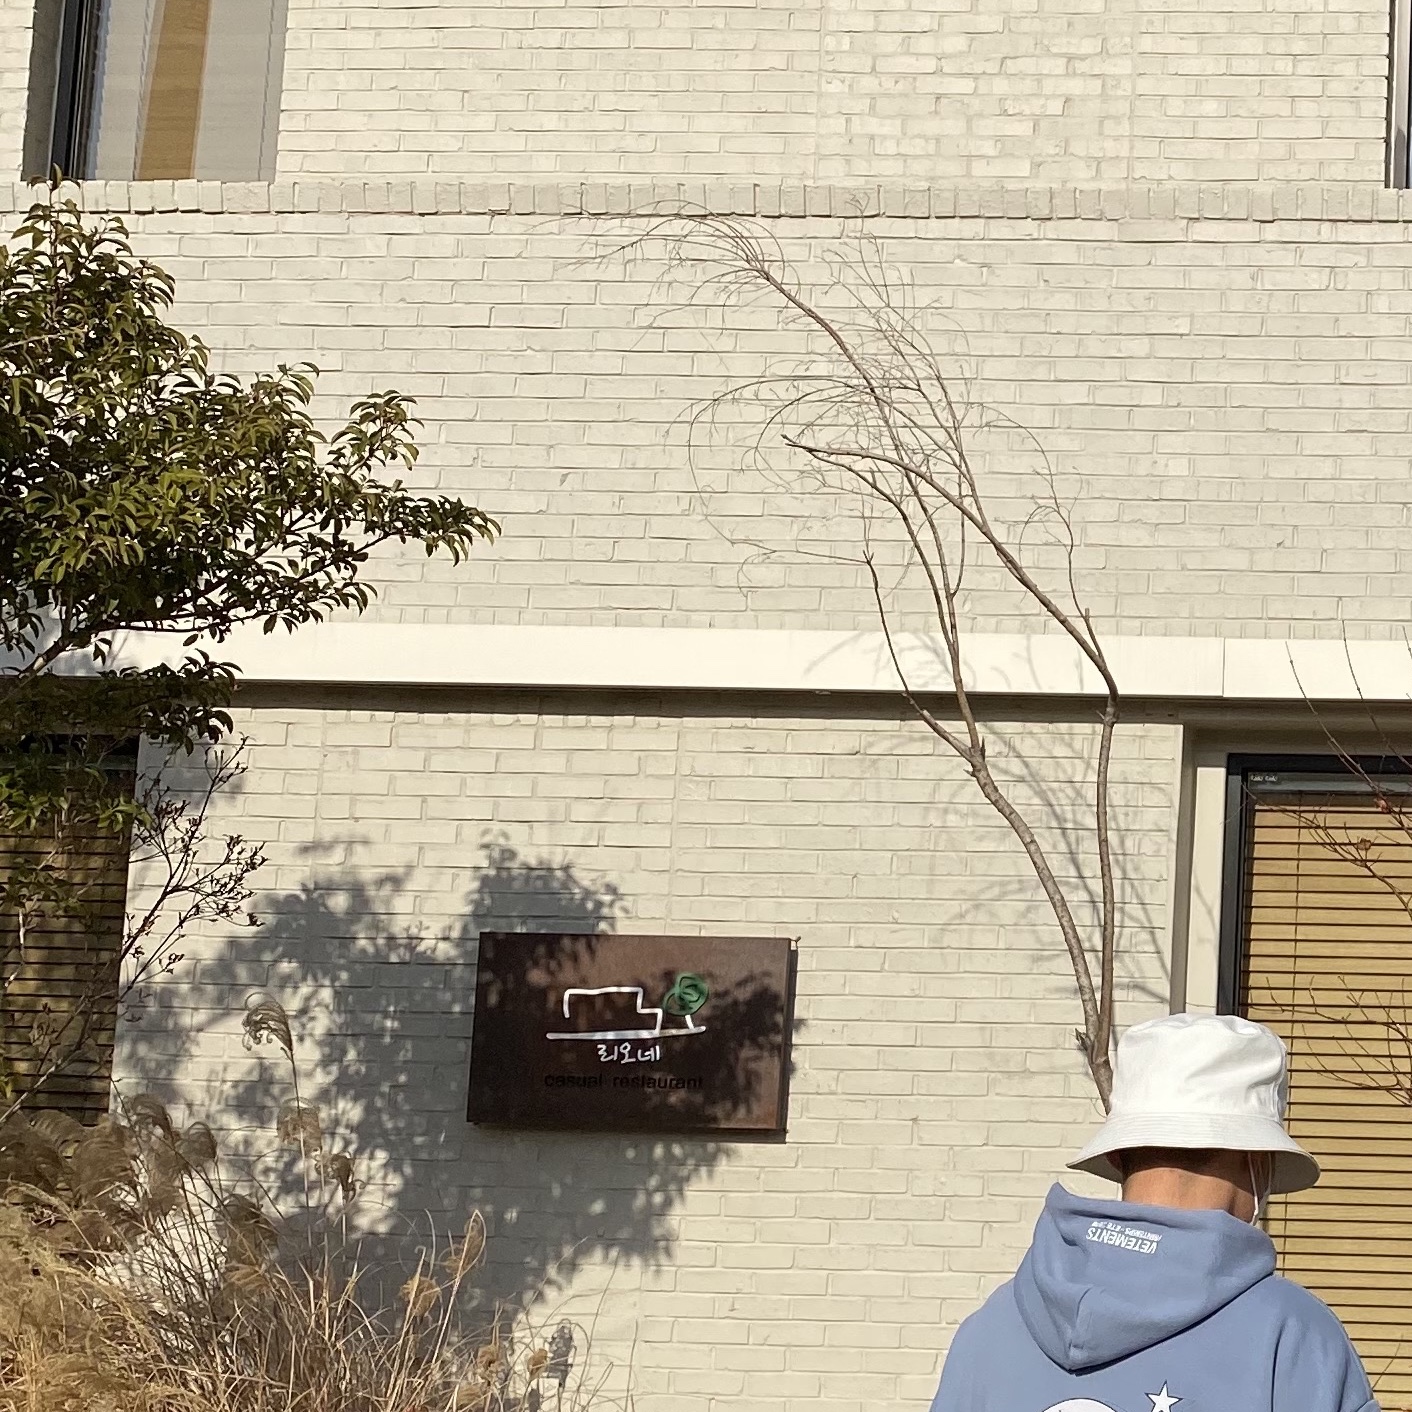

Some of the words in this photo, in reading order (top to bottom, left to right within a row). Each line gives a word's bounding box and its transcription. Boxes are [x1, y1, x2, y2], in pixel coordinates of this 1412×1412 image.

[597, 1042, 661, 1064] 리오네
[543, 1073, 603, 1089] casual
[612, 1074, 704, 1090] restaurant
[1086, 1227, 1158, 1254] VETEMENTS
